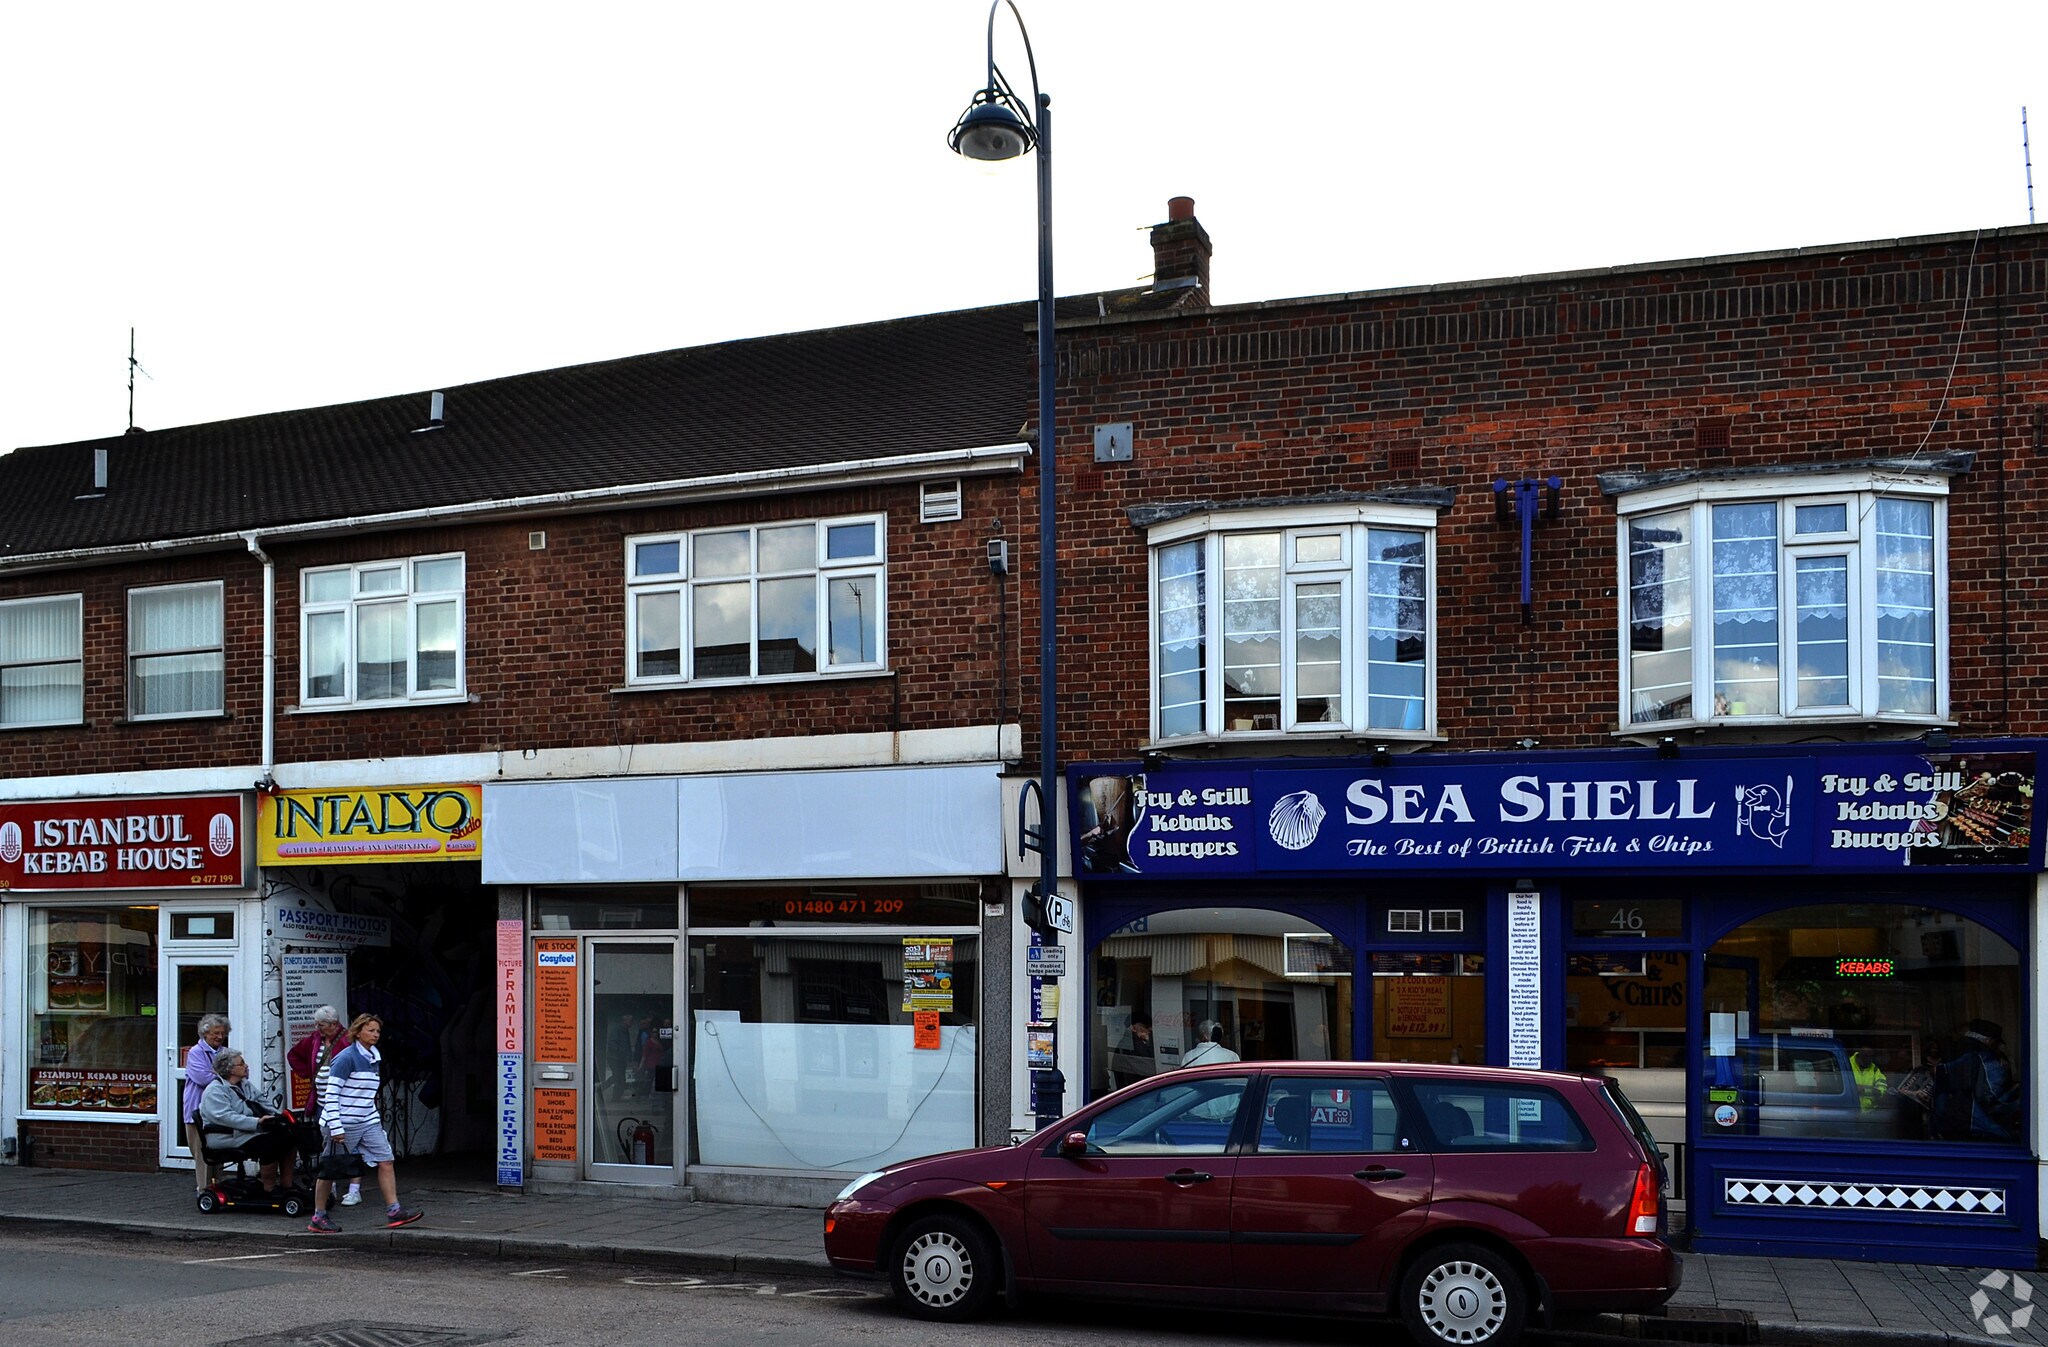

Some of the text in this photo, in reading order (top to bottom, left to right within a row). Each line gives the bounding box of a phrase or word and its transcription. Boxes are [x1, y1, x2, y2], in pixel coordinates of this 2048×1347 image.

[1821, 772, 1963, 796] Fry & Grill
[1134, 787, 1251, 809] Fry & Grill
[1345, 775, 1716, 825] SEA SHELL
[274, 790, 472, 838] INTALYO
[1837, 801, 1940, 821] Kebabs
[33, 814, 191, 847] ISTANBUL
[450, 816, 481, 841] Studio
[1150, 814, 1233, 832] Kebabs
[1148, 839, 1239, 859] Burgers
[1346, 834, 1714, 858] The Best of British Fish & Chips
[1831, 829, 1942, 851] Burgers
[23, 847, 204, 874] KEBAB HOUSE
[202, 875, 233, 883] 477 199
[785, 900, 834, 914] 01480
[838, 900, 867, 913] 471
[873, 899, 904, 913] 209
[1054, 900, 1063, 924] P
[280, 909, 340, 926] PASSPORT
[343, 915, 387, 932] PHOTOS
[1610, 908, 1644, 929] 46
[305, 932, 321, 940] Only
[539, 953, 574, 965] Cosyfeet
[1839, 962, 1891, 974] KEBABS
[1425, 986, 1443, 994] MEAL
[1427, 977, 1445, 985] CHIPS
[1625, 982, 1682, 1006] CHIPS
[505, 968, 515, 1050] FRAMING
[1392, 1024, 1408, 1034] only
[39, 1071, 153, 1081] ISTANBUL KEBAB HOUSE
[503, 1060, 517, 1105] DIGITAL
[502, 1109, 517, 1161] PRINTING
